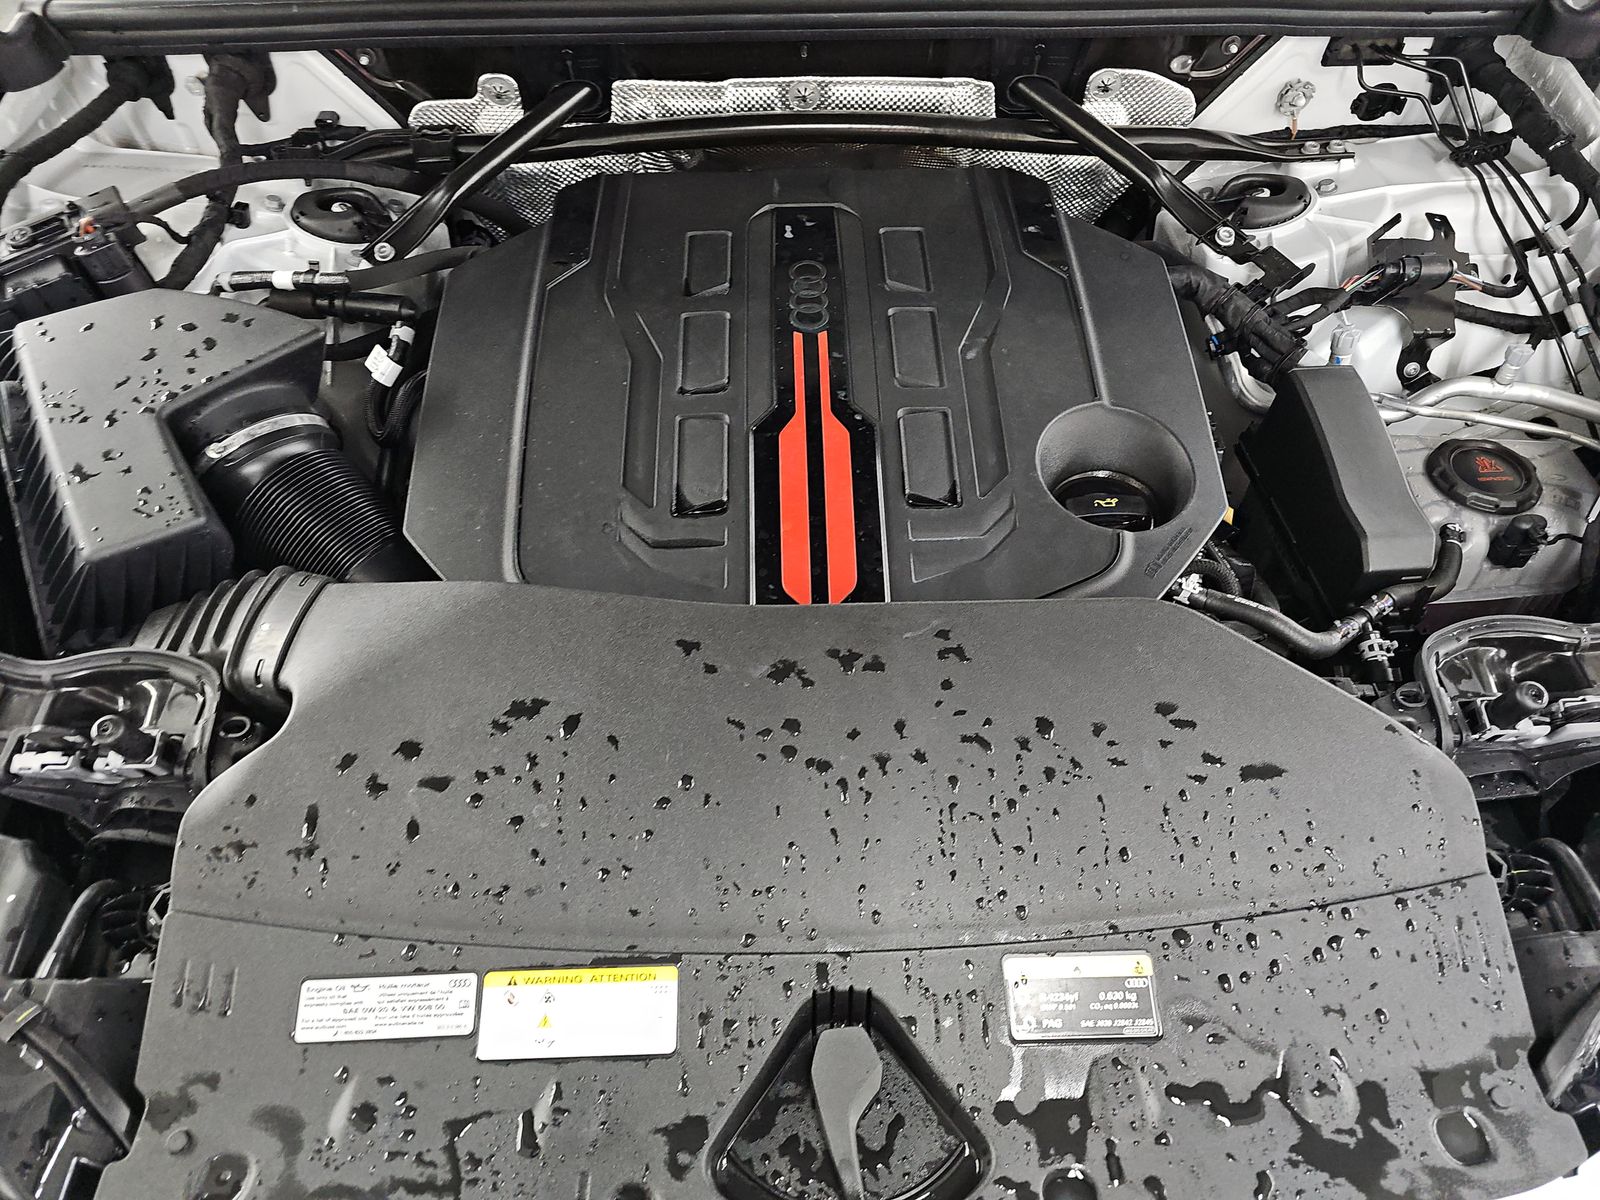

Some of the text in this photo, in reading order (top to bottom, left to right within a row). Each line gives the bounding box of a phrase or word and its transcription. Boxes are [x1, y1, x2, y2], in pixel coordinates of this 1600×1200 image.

[523, 972, 657, 985] WARNING ATTENTION
[1125, 990, 1138, 1002] kg
[1041, 1018, 1063, 1028] PAG
